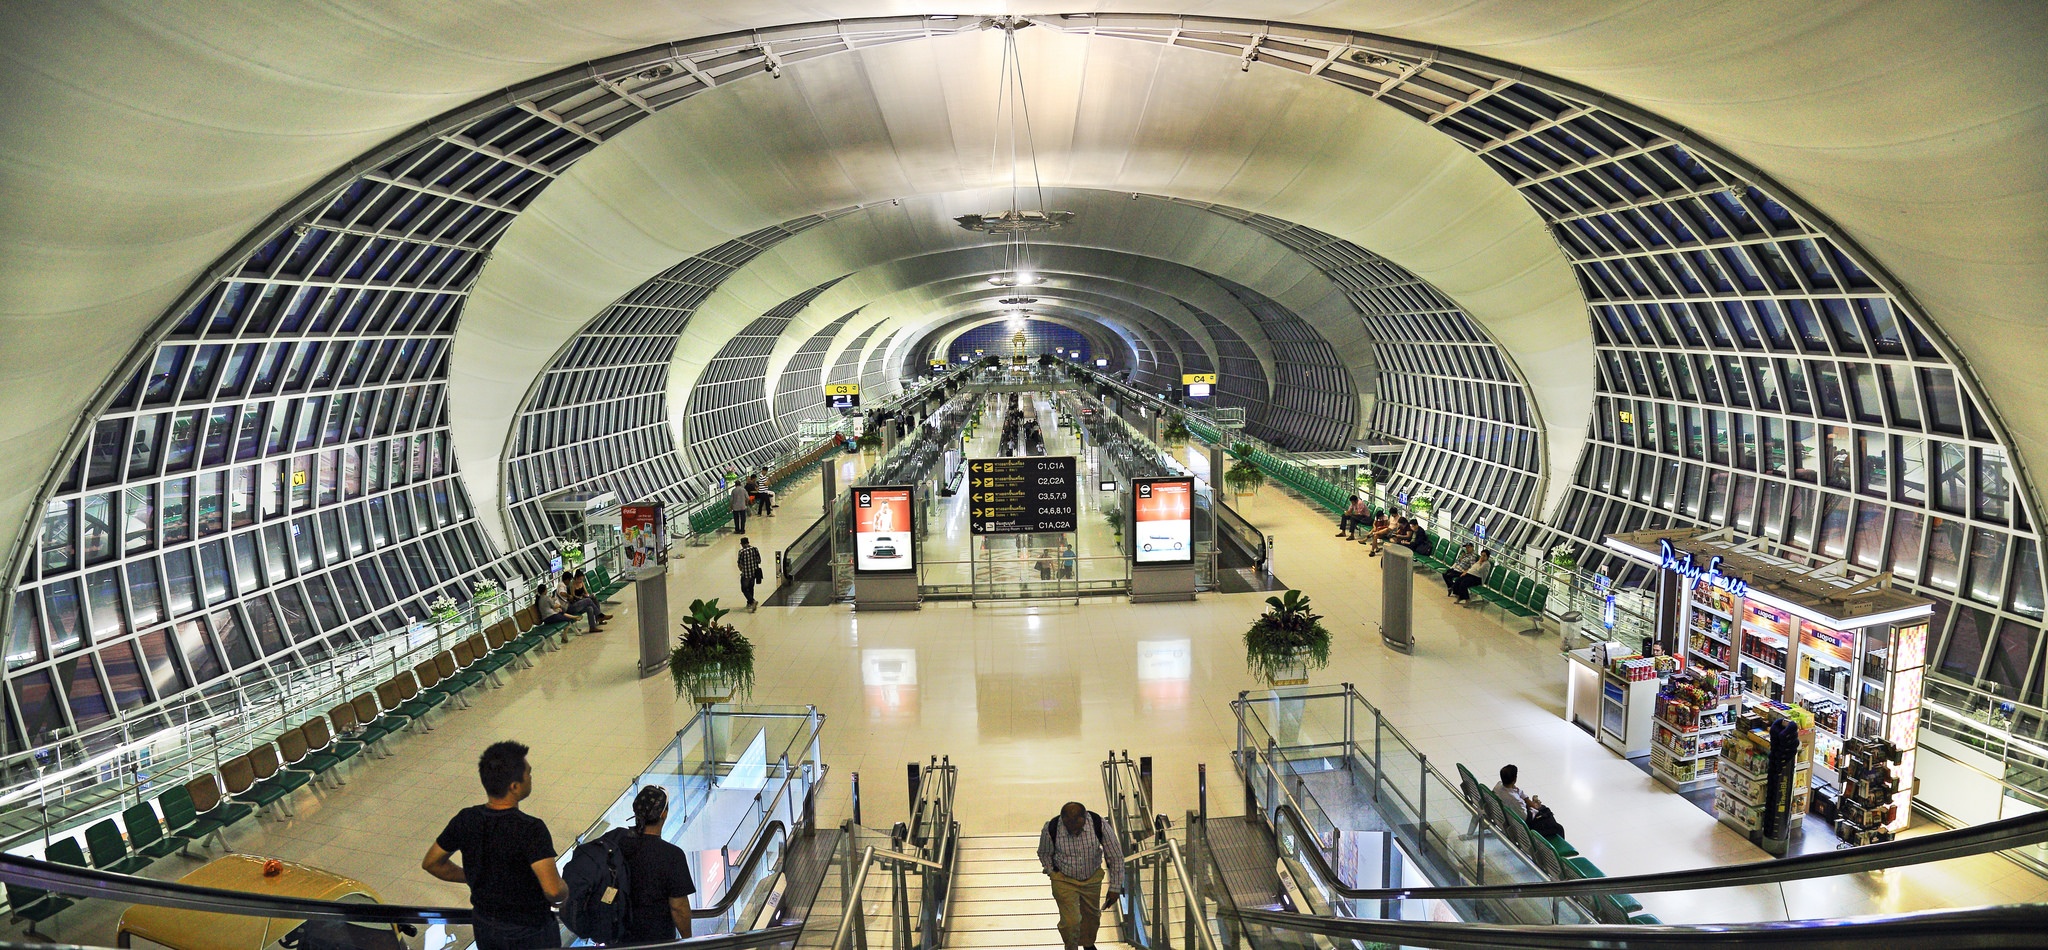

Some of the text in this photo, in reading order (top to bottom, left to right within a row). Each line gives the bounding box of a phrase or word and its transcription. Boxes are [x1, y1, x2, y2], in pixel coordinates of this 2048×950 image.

[1193, 375, 1205, 383] C4
[836, 385, 848, 393] C3
[1037, 462, 1065, 471] C1,C1A
[293, 474, 304, 485] C1
[1037, 477, 1065, 486] C2,C2A
[1038, 492, 1067, 501] C3,5,7,9
[1038, 506, 1072, 516] C4,6,8,10
[1038, 521, 1071, 530] C1A,C2A
[1660, 539, 1748, 597] Duty Free
[1757, 609, 1775, 621] LIQUOR
[1816, 631, 1836, 644] LIQUOR
